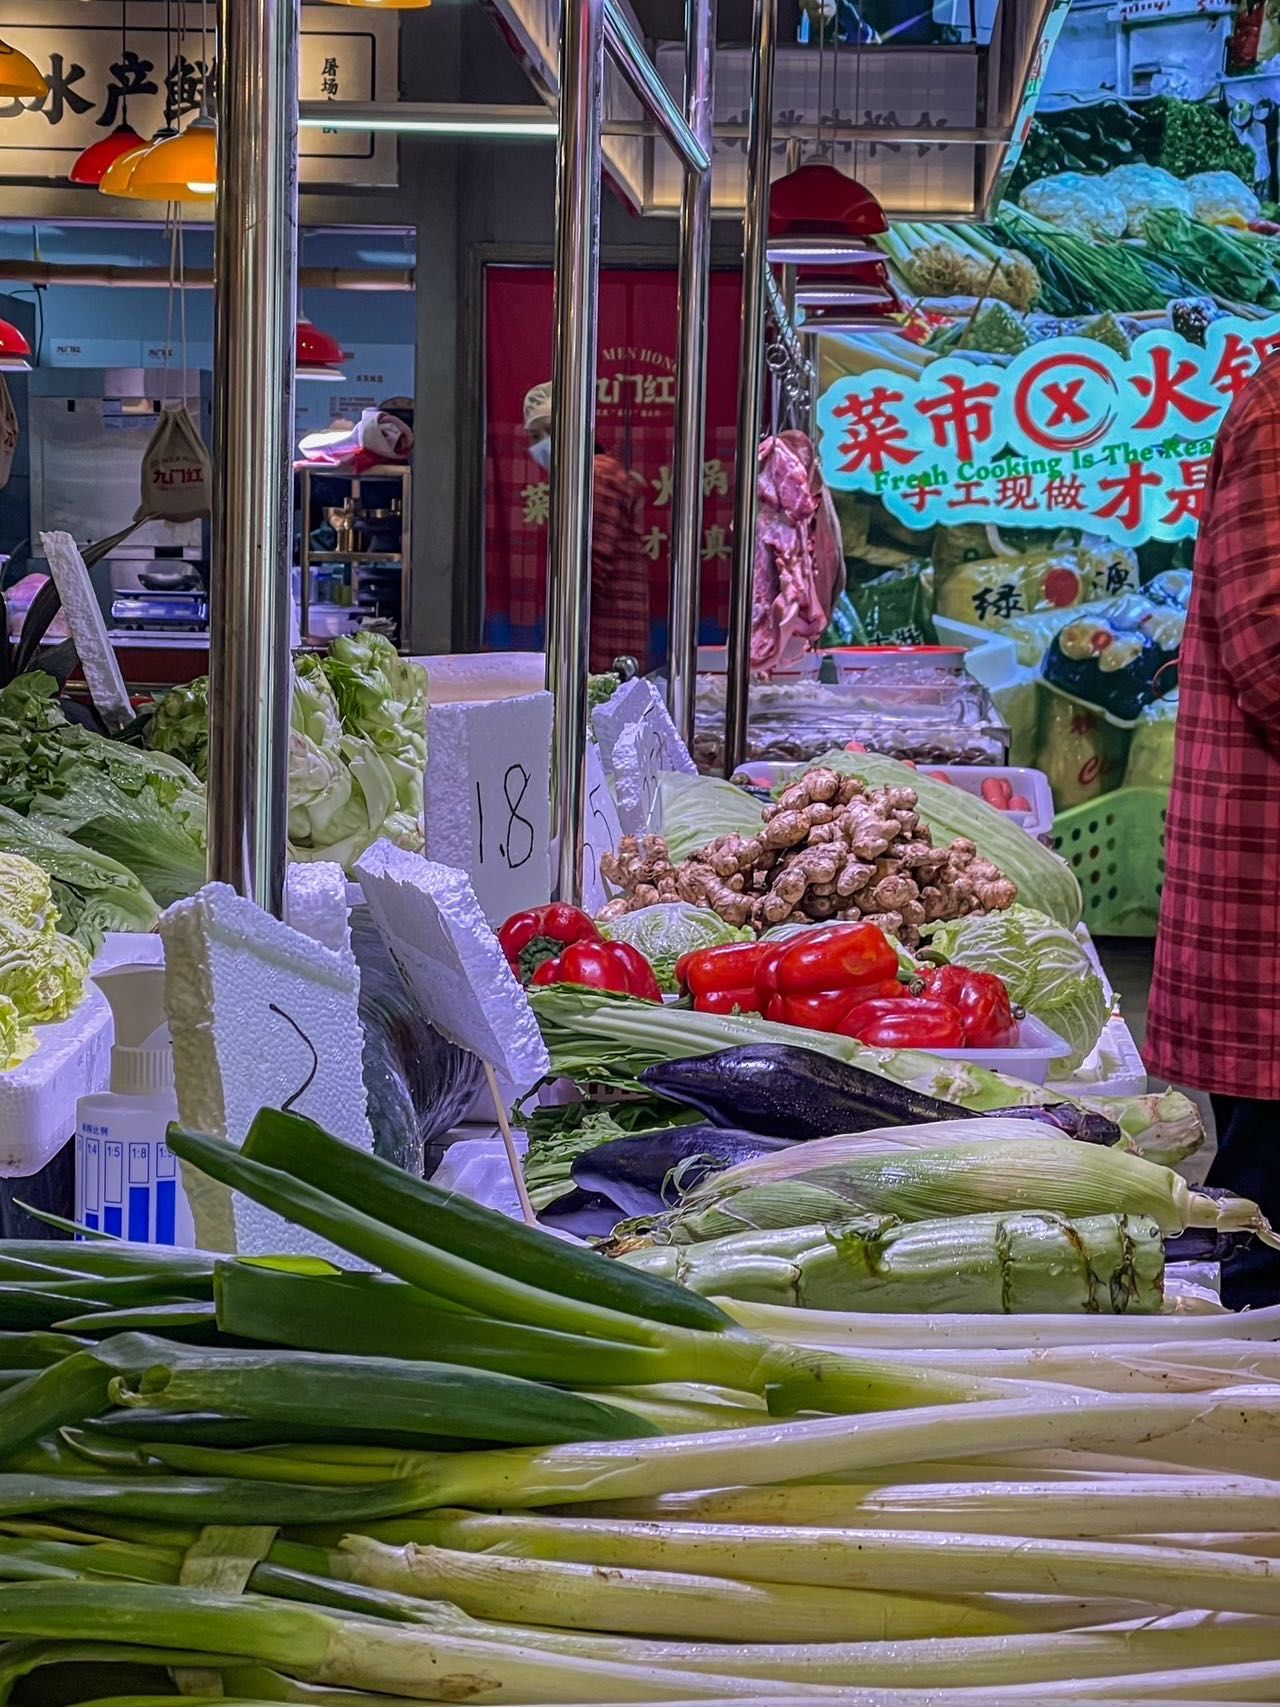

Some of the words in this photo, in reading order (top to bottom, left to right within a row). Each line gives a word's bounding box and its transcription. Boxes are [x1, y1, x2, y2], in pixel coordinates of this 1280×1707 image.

[0, 51, 217, 126] 水产鲜
[153, 468, 203, 484] 九门红
[957, 455, 1063, 481] Cooking
[1072, 449, 1094, 469] Is
[1103, 441, 1154, 466] The
[1163, 437, 1213, 459] Rea
[641, 525, 732, 560] 才真
[971, 583, 1025, 621] 绿
[476, 763, 532, 869] 1.8
[87, 1143, 97, 1155] 1:4
[107, 1146, 120, 1158] 1:5
[132, 1148, 147, 1159] 1:8
